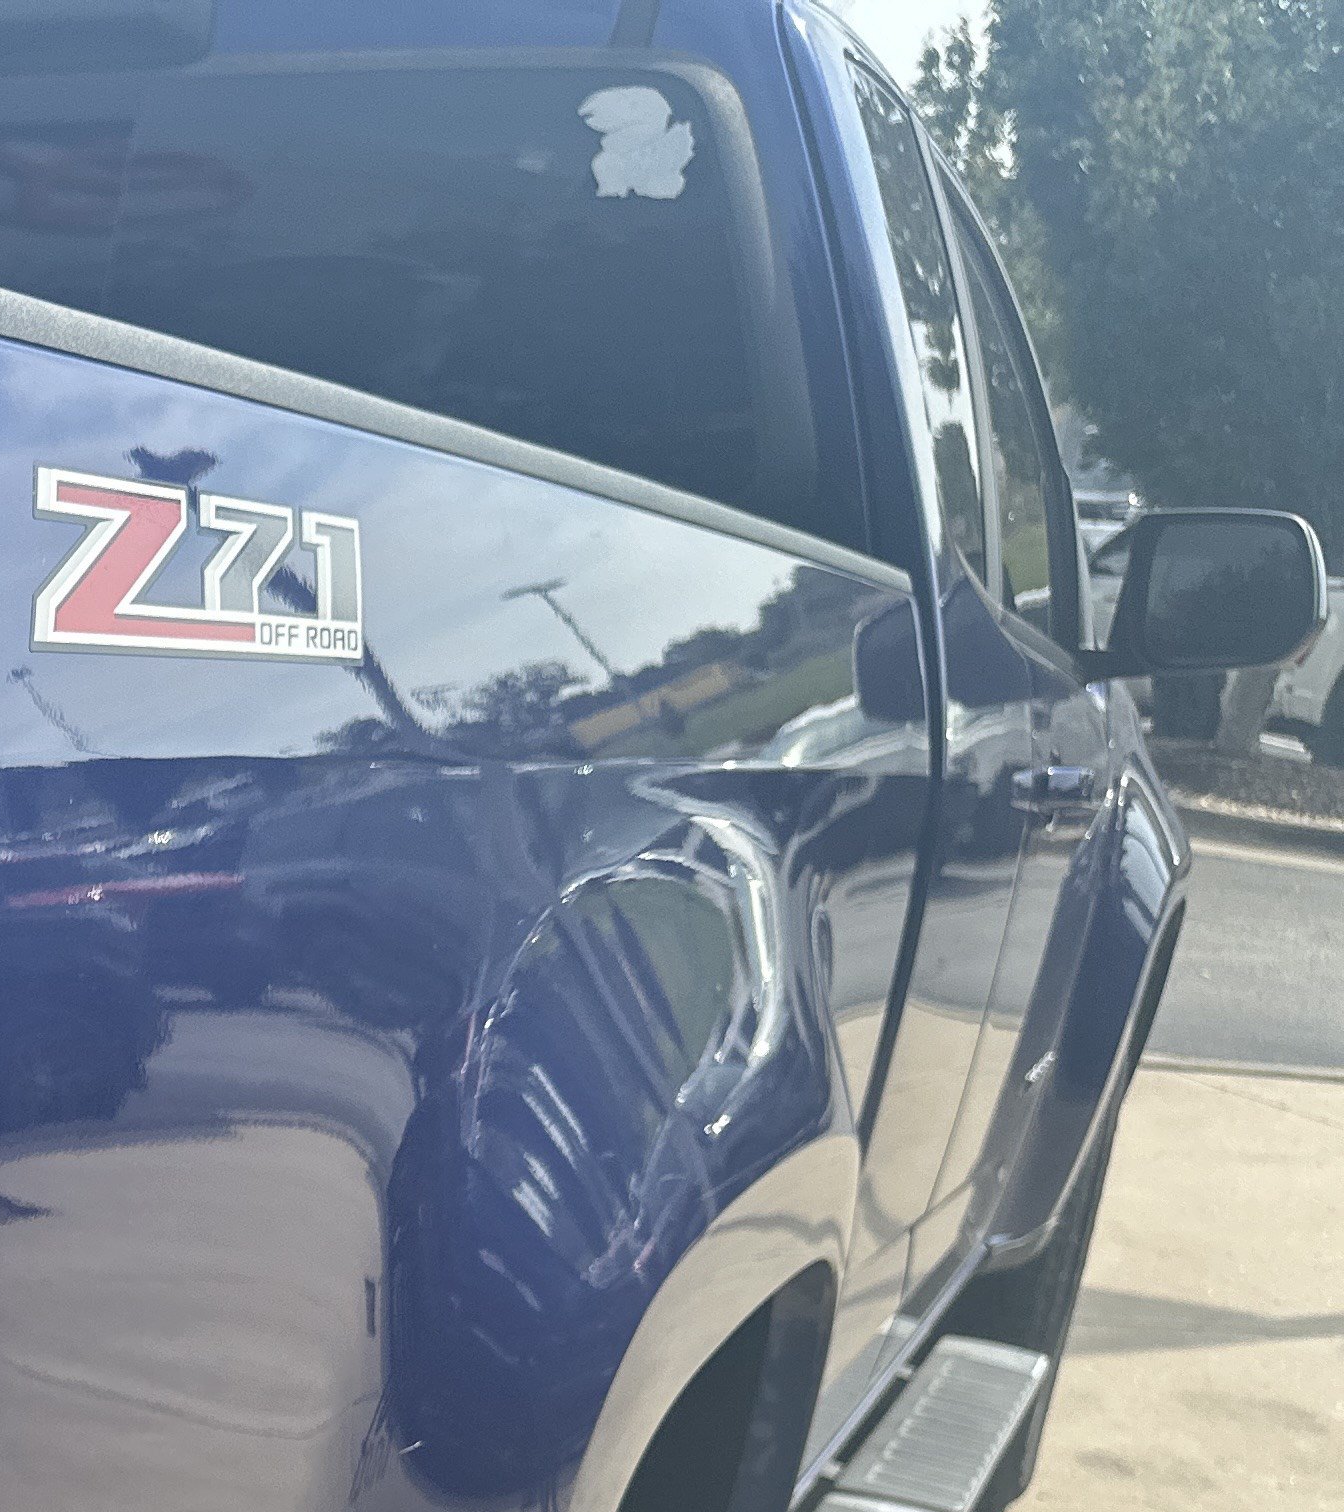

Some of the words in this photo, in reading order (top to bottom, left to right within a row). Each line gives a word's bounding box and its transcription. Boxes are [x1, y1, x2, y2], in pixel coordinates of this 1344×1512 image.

[32, 465, 362, 656] Z71
[260, 622, 299, 647] OFF
[306, 625, 358, 651] ROAD
